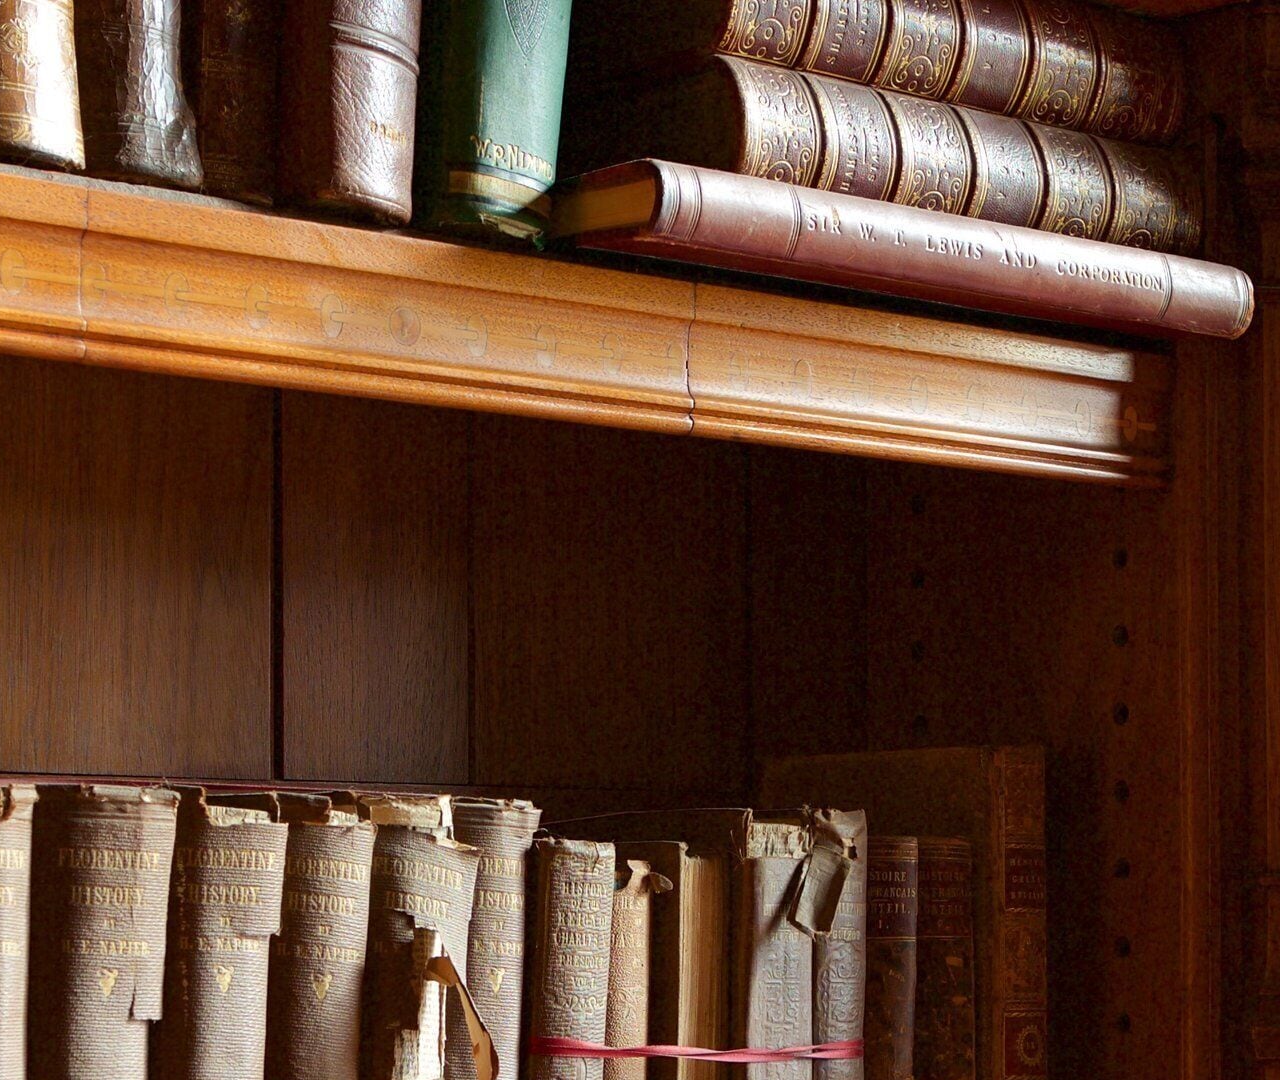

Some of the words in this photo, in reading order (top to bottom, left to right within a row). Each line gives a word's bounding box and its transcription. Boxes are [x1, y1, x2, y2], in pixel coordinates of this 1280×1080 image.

[806, 213, 842, 235] SIR
[858, 223, 877, 243] W.
[893, 230, 908, 248] T.
[924, 235, 984, 261] LEWIS
[999, 248, 1037, 269] AND
